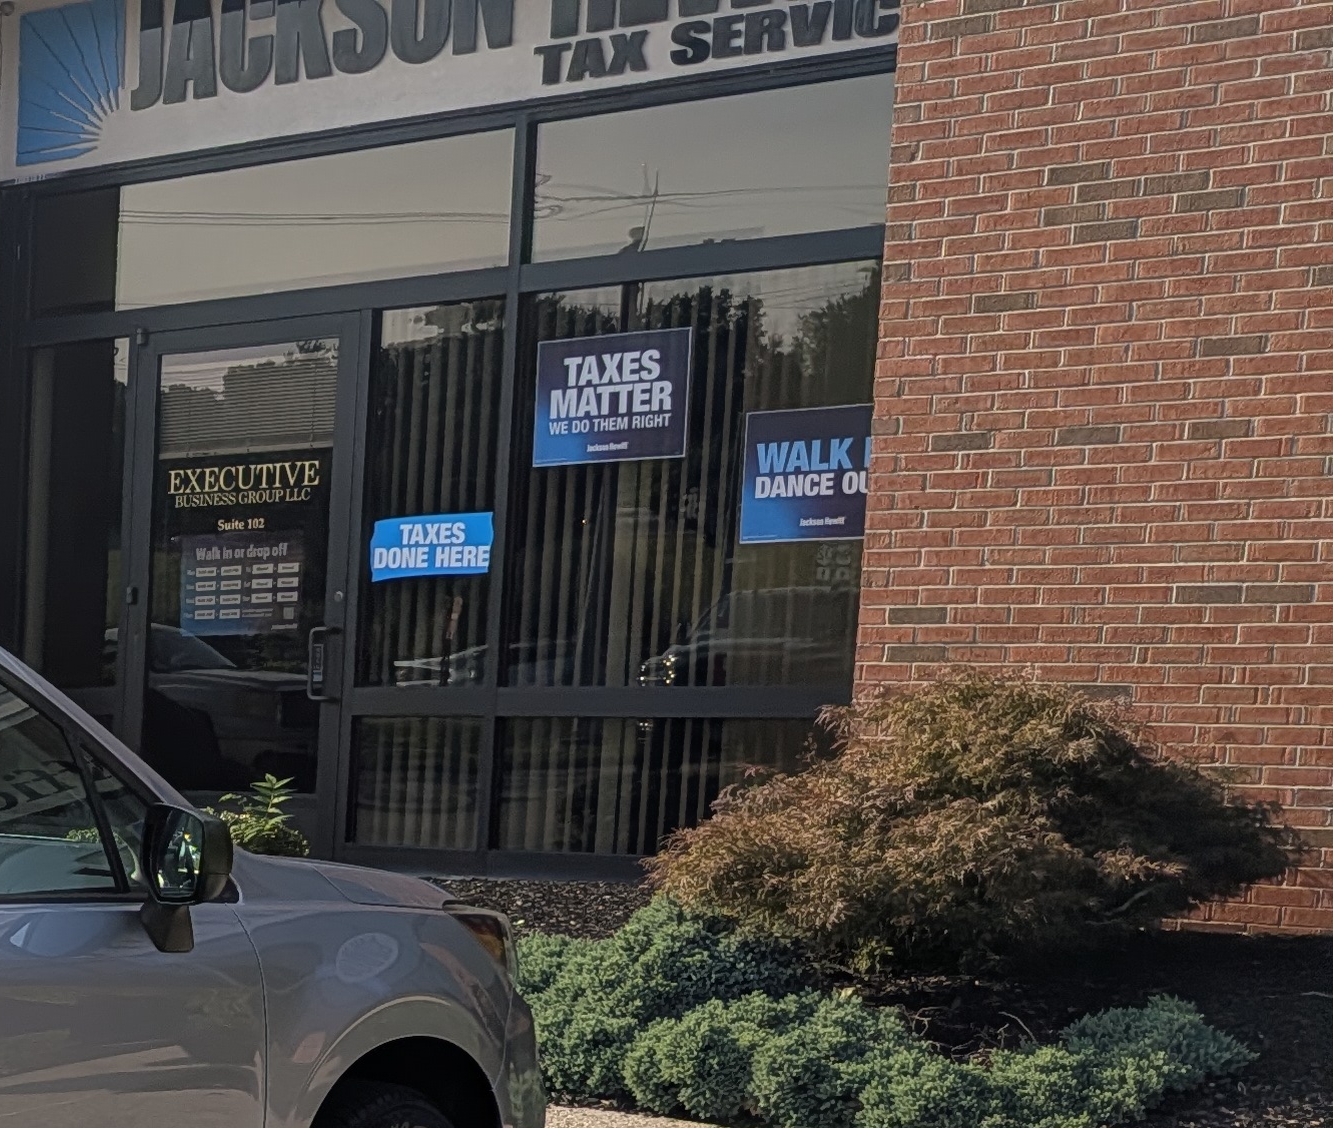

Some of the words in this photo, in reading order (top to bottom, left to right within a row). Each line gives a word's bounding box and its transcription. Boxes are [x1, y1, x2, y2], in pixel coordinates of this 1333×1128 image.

[533, 29, 650, 86] TAX
[670, 0, 900, 66] SERVIC
[563, 349, 661, 387] TAXES
[549, 380, 673, 420] MATTER
[548, 420, 568, 436] WE
[571, 419, 590, 434] DO
[593, 416, 629, 432] THEM
[632, 413, 672, 429] RIGHT
[756, 437, 854, 474] WALK
[167, 460, 320, 495] EXECUTIVE
[754, 472, 835, 499] DANCE
[175, 493, 237, 508] BUSINESS
[239, 489, 284, 505] GROUP
[285, 487, 311, 502] LLC
[217, 519, 245, 531] Suite
[247, 518, 265, 529] 102
[399, 522, 466, 545] TAXES
[195, 546, 221, 561] Walk
[222, 546, 233, 560] in
[234, 548, 245, 559] or
[246, 543, 270, 560] drop
[271, 542, 288, 557] off
[373, 546, 430, 569] DONE
[435, 545, 491, 568] HERE
